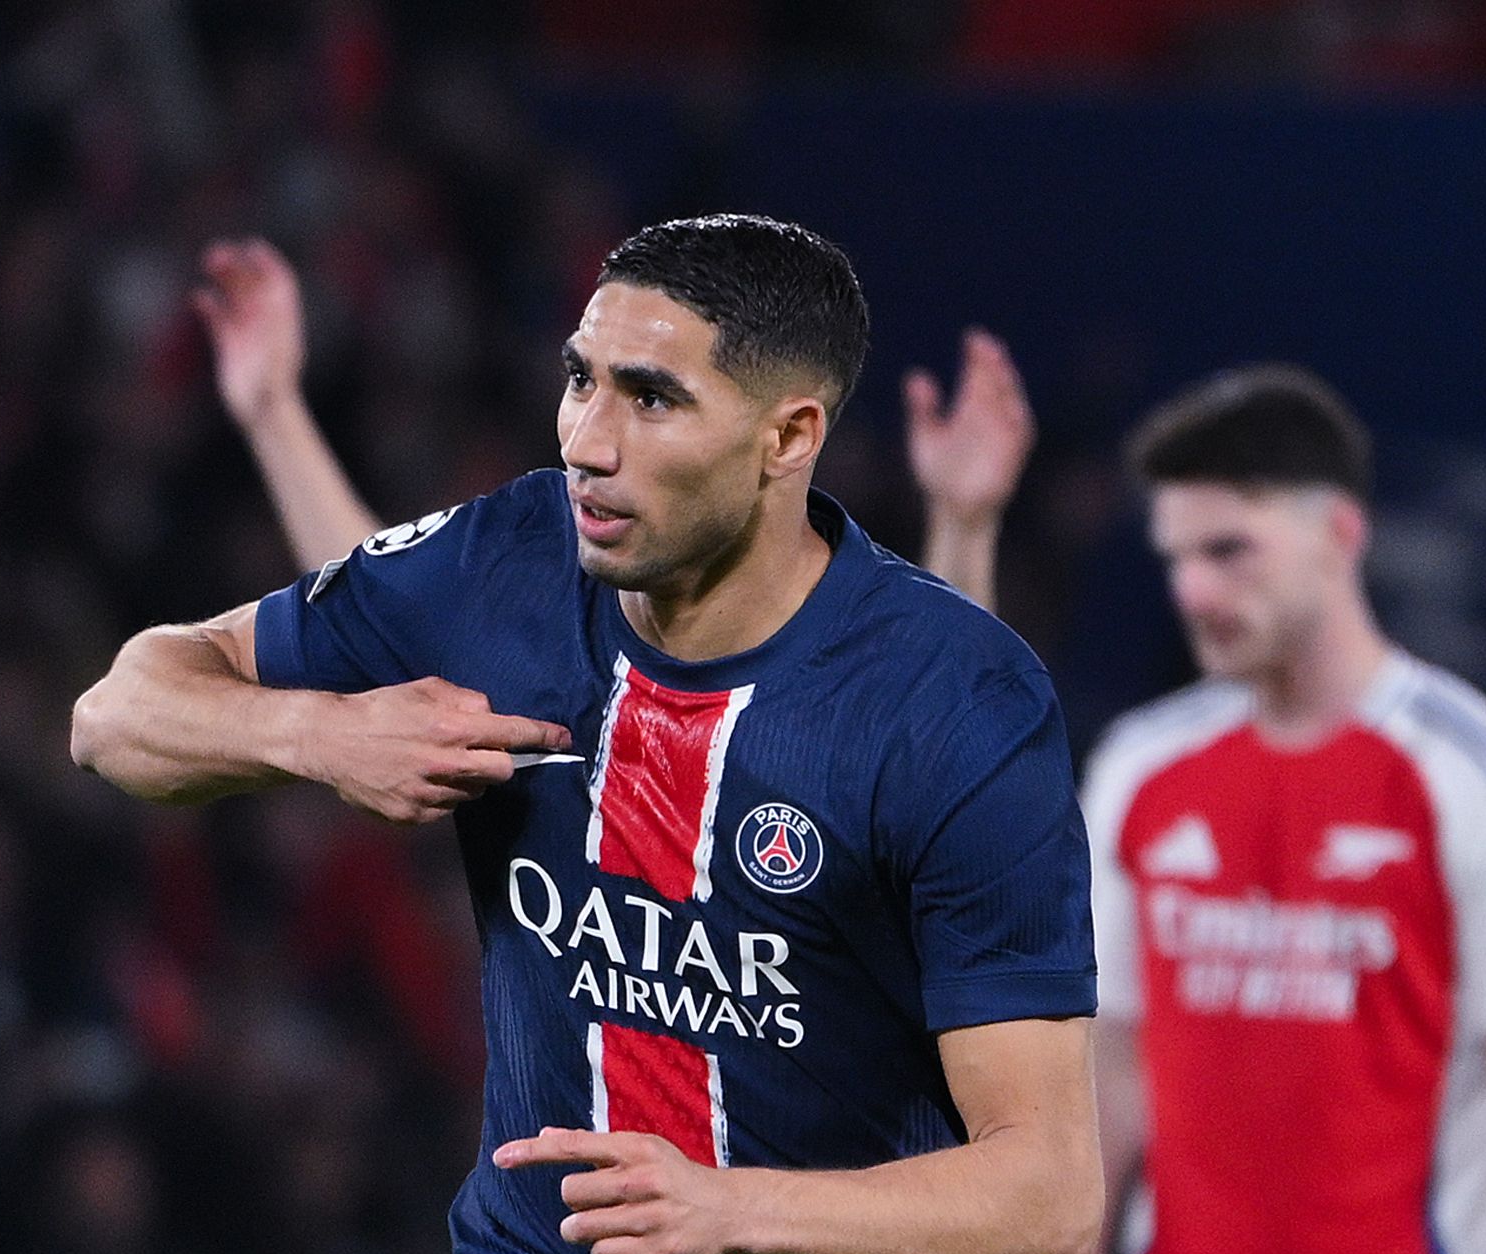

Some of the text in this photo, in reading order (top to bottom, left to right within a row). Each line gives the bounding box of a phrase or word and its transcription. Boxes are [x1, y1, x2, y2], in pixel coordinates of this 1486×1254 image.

[754, 807, 811, 836] PARIS
[509, 857, 801, 997] QATAR
[568, 959, 805, 1049] AIRWAYS
